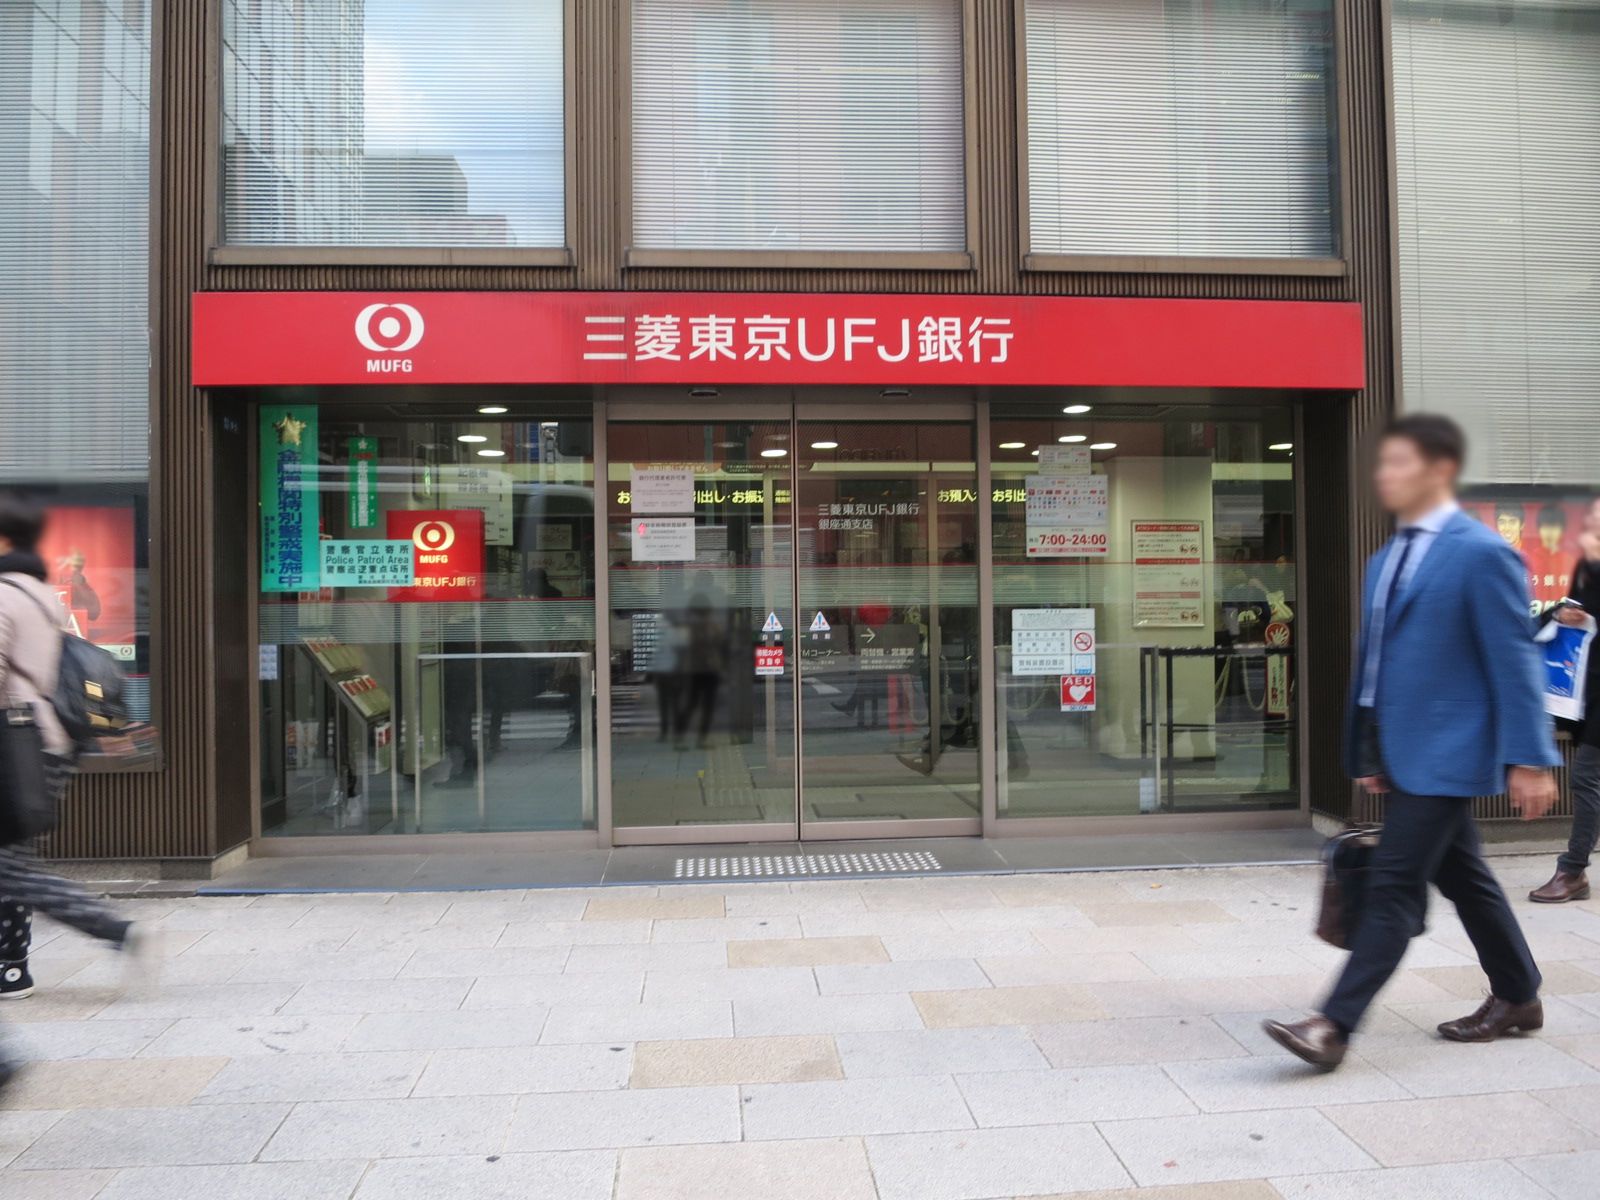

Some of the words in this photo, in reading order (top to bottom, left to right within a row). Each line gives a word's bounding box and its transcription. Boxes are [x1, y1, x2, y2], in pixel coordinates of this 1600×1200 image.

[583, 314, 1014, 363] 三菱東京UFJ銀行
[366, 359, 413, 372] MUFG
[818, 503, 920, 516] 三菱東京UFJ銀行
[818, 519, 873, 530] 銀座通支店
[326, 545, 409, 555] 警察官立寄所
[325, 555, 354, 564] Police
[357, 555, 384, 564] Patrol
[388, 555, 409, 564] Area
[419, 555, 448, 564] MUFG
[1064, 676, 1093, 685] AED
